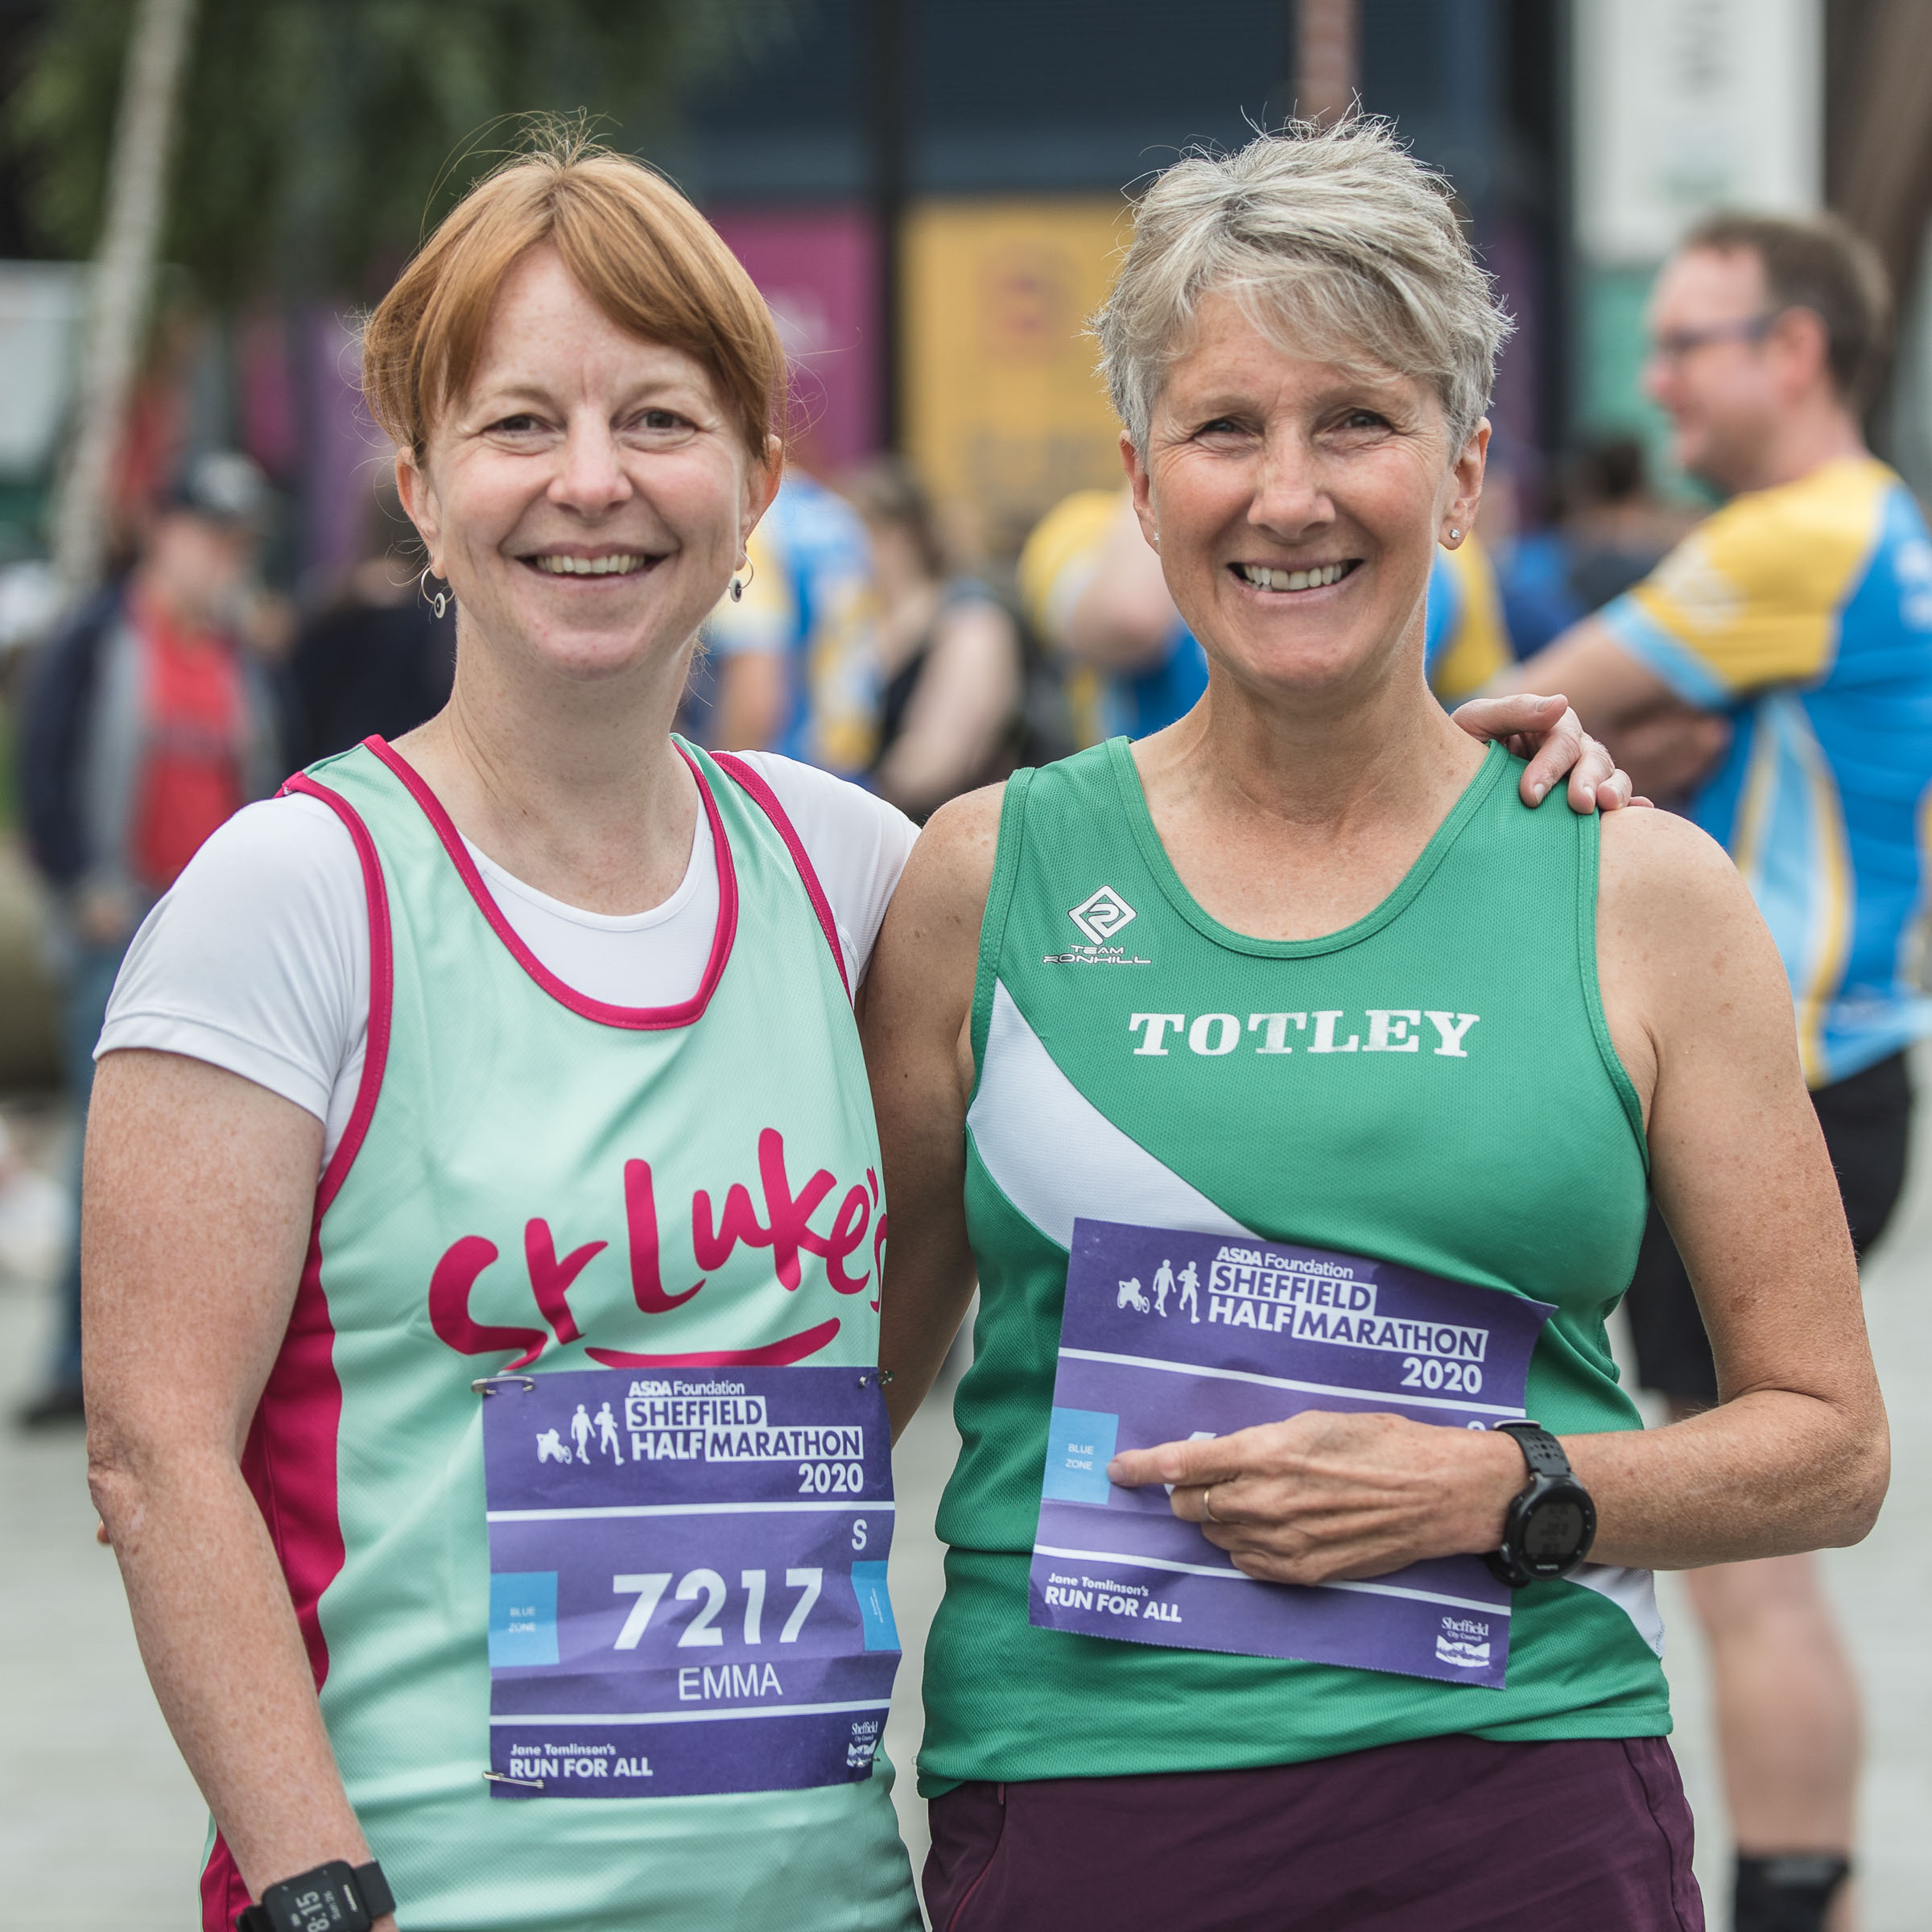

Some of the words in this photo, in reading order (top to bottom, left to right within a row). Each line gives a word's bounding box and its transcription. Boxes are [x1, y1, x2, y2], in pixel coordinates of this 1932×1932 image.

[1042, 952, 1152, 964] RONHILL
[1070, 944, 1125, 955] TEAM
[1129, 1009, 1480, 1057] TOTLEY
[1216, 1246, 1263, 1268] ASDA
[1265, 1253, 1353, 1280] Foundation
[428, 1217, 608, 1371] St
[1213, 1265, 1371, 1311] SHEFFIELD
[1208, 1295, 1296, 1333] HALF
[1298, 1310, 1483, 1358] MARATHON
[629, 1381, 672, 1397] ASDA
[673, 1380, 745, 1396] Foundation
[1400, 1356, 1483, 1394] 2020
[630, 1400, 762, 1427] SHEFFIELD
[631, 1430, 703, 1461] HALF
[709, 1430, 861, 1458] MARATHON
[1068, 1443, 1094, 1455] BLUE
[798, 1462, 864, 1494] 2020
[1065, 1458, 1093, 1471] ZONE
[851, 1519, 867, 1550] S
[1048, 1572, 1079, 1587] Jane
[1081, 1576, 1150, 1597] Tomlinson's
[509, 1606, 536, 1618] BLUE
[613, 1567, 823, 1650] 7217
[1045, 1586, 1093, 1610] RUN
[1096, 1593, 1139, 1617] FOR
[1143, 1601, 1183, 1623] ALL
[509, 1621, 537, 1633] ZONE
[1441, 1616, 1489, 1637] Sheffield
[679, 1662, 783, 1701] EMMA
[851, 1720, 878, 1736] Sheffield
[510, 1744, 542, 1756] Jane
[544, 1743, 617, 1756] Tomlinson's
[510, 1758, 559, 1778] RUN
[564, 1757, 608, 1777] FOR
[613, 1757, 654, 1777] ALL
